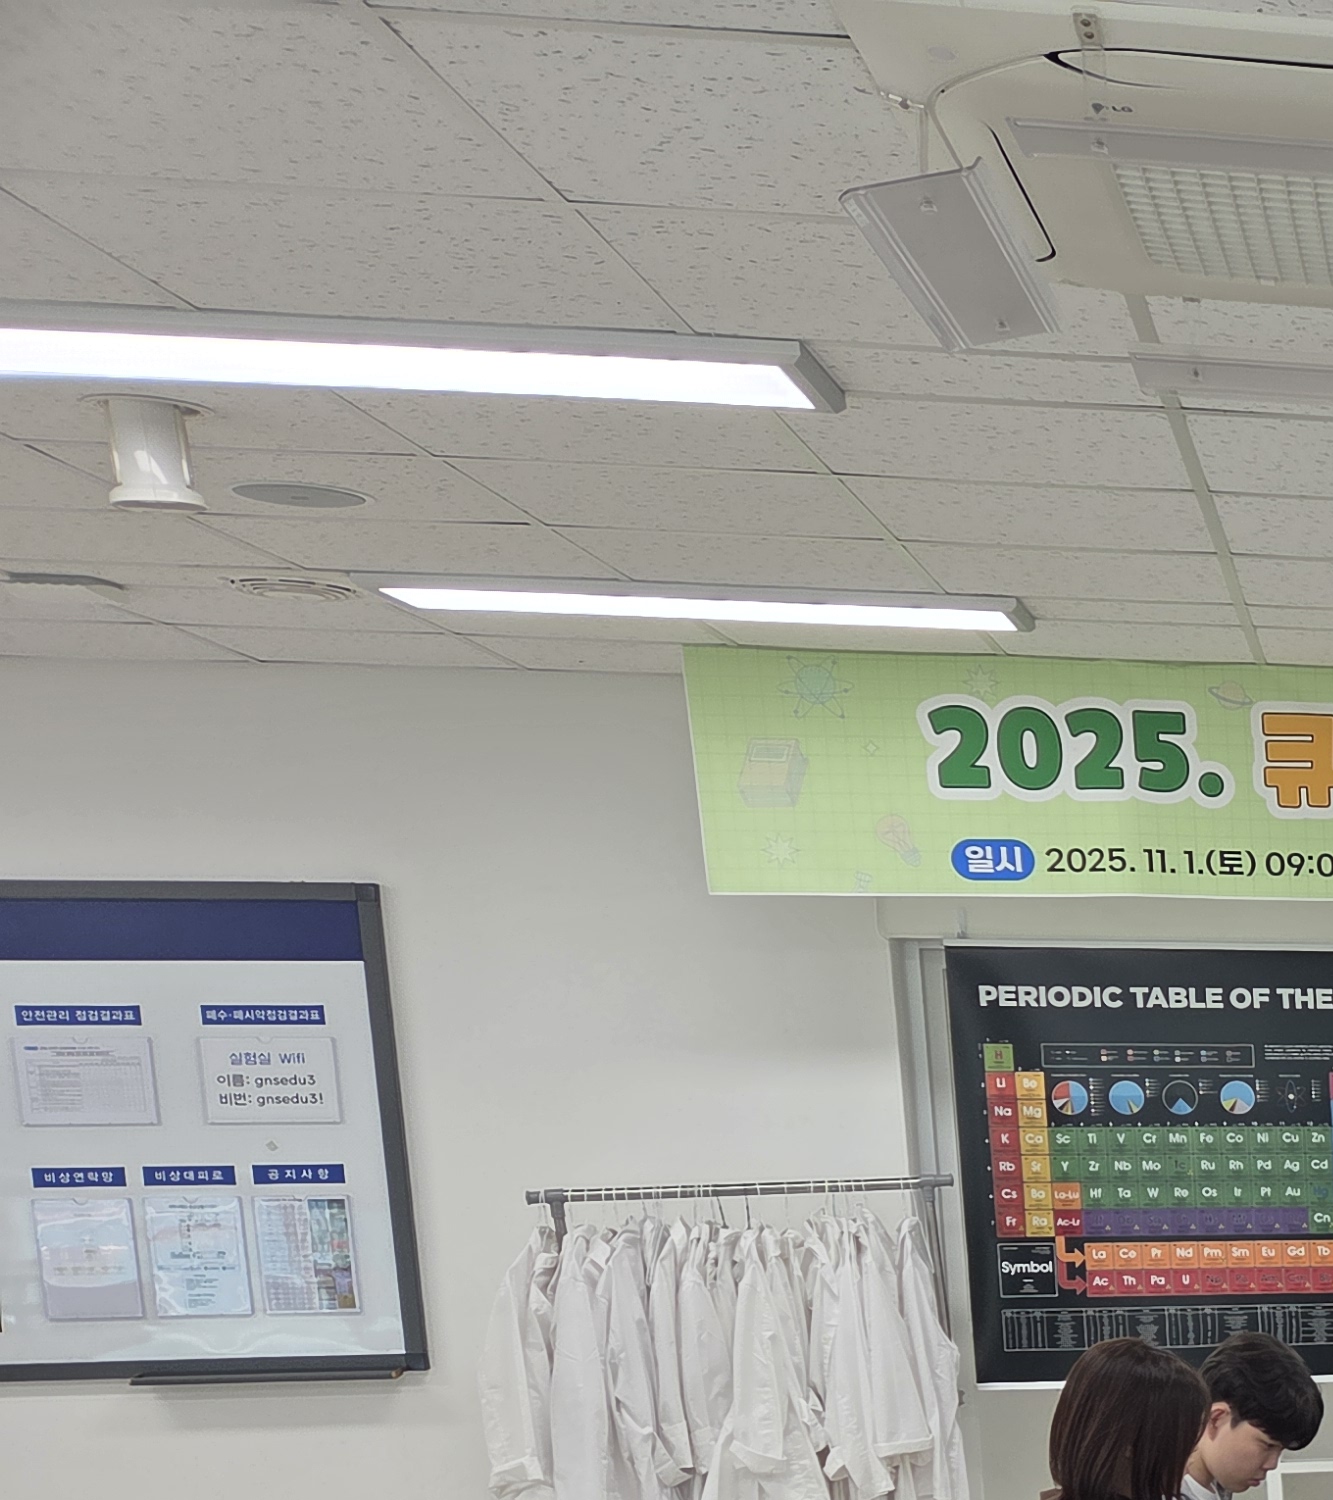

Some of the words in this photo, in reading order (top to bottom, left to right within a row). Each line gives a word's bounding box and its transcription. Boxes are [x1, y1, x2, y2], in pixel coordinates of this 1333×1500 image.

[928, 705, 1224, 797] 2025.
[964, 845, 1024, 873] 일시
[1045, 848, 1136, 873] 2025.
[978, 985, 1122, 1008] PERIODIC
[1130, 986, 1225, 1009] TABLE
[1229, 987, 1269, 1009] OF
[1276, 988, 1333, 1009] THE
[21, 1010, 70, 1022] 안전관리
[75, 1009, 136, 1022] 점검결과표
[229, 1052, 272, 1065] 실험실
[279, 1051, 305, 1064] Wifi
[217, 1073, 250, 1087] 이름:
[254, 1073, 316, 1087] gnsedu3
[219, 1093, 251, 1106] 비번:
[256, 1093, 324, 1107] gnsedu3!
[995, 1106, 1012, 1116] Na
[1023, 1106, 1041, 1118] Mg
[1001, 1134, 1009, 1143] K
[1025, 1134, 1043, 1143] Ca
[1056, 1134, 1070, 1144] Sc
[1117, 1133, 1125, 1143] V
[1143, 1133, 1157, 1143] Cr
[1169, 1133, 1187, 1143] Mn
[1226, 1133, 1243, 1142] Co
[1282, 1132, 1299, 1142] Cu
[1312, 1132, 1325, 1142] Zn
[999, 1162, 1015, 1171] Rb
[1061, 1161, 1069, 1171] Y
[1089, 1161, 1100, 1171] Zr
[1115, 1161, 1132, 1171] Nb
[1142, 1161, 1161, 1170] Mo
[1201, 1160, 1215, 1170] Ru
[1229, 1160, 1243, 1170] Rh
[1257, 1160, 1272, 1170] Pd
[1284, 1160, 1300, 1172] Ag
[1311, 1159, 1328, 1169] Cd
[44, 1171, 113, 1183] 비상연락망
[154, 1169, 224, 1182] 비상대피로
[1002, 1188, 1017, 1198] Cs
[1031, 1188, 1045, 1198] Ba
[1118, 1188, 1131, 1198] Ta
[1147, 1188, 1159, 1198] W
[1202, 1187, 1217, 1197] Os
[1234, 1187, 1242, 1197] Ir
[1261, 1187, 1271, 1197] Pt
[1285, 1187, 1300, 1196] Au
[1006, 1217, 1017, 1226] Fr
[1032, 1216, 1048, 1226] Ra
[1314, 1213, 1331, 1222] Cn
[1092, 1249, 1107, 1259] La
[1151, 1248, 1162, 1258] Pr
[1176, 1248, 1193, 1258] Nd
[1204, 1247, 1222, 1257] Pm
[1231, 1246, 1249, 1256] Sm
[1262, 1247, 1276, 1256] Eu
[1287, 1246, 1305, 1256] Gd
[1317, 1246, 1330, 1255] Tb
[1002, 1261, 1053, 1276] Symbol
[1093, 1276, 1108, 1286] Ac
[1123, 1276, 1136, 1285] Th
[1151, 1275, 1165, 1285] Pa
[1182, 1275, 1190, 1284] U
